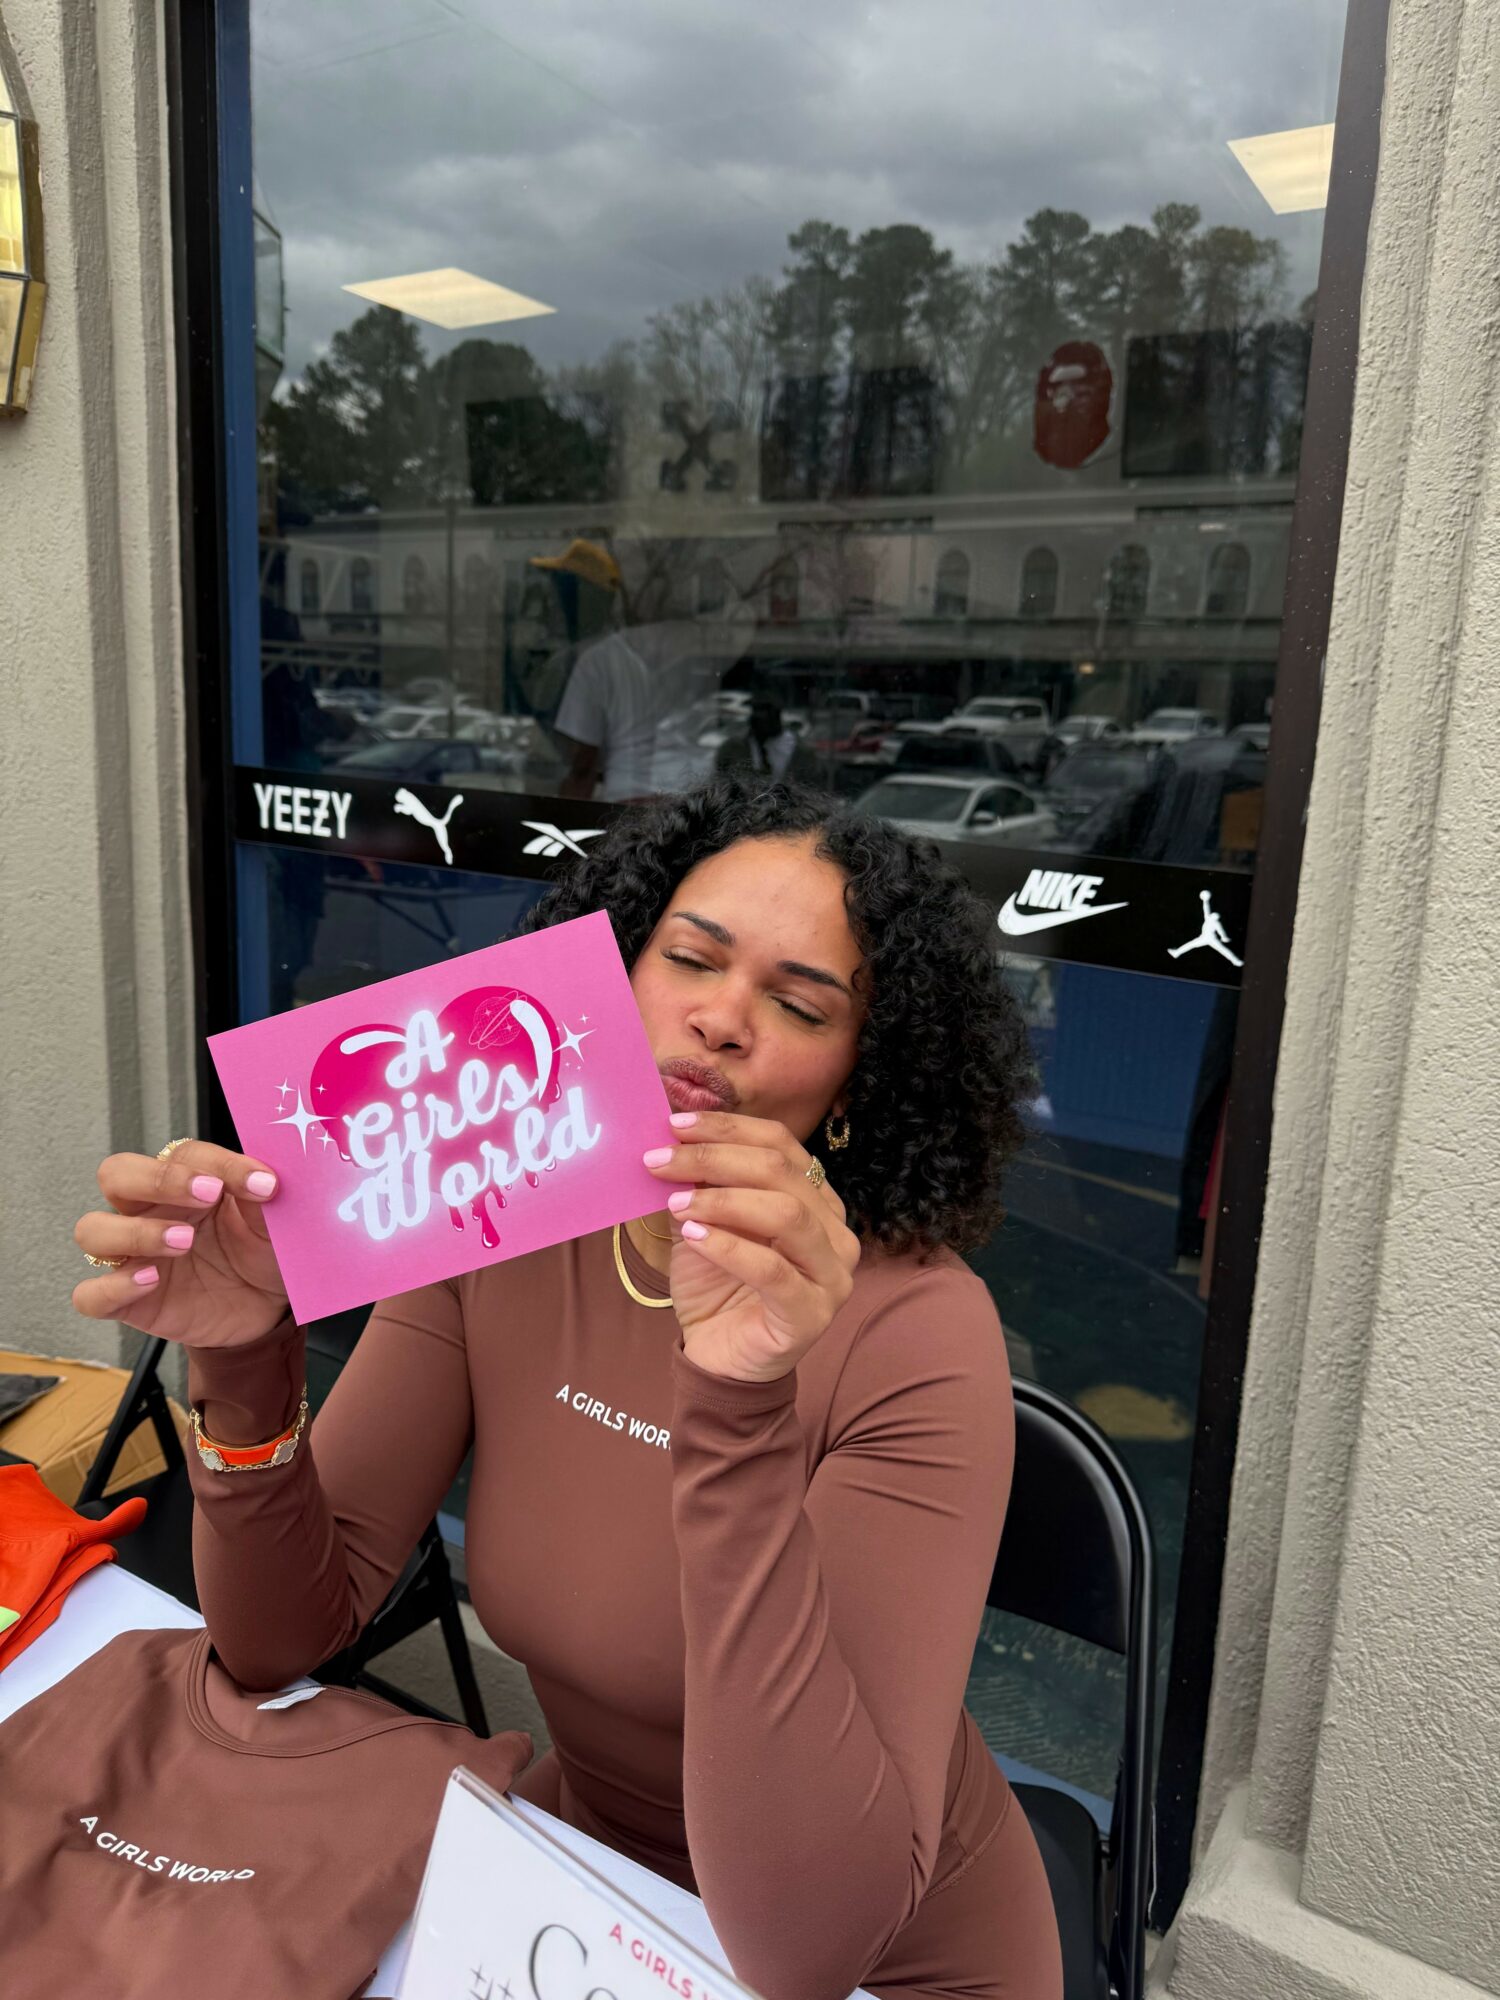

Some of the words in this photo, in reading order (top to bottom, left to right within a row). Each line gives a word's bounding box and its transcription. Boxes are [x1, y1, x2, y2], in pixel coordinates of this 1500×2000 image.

[253, 782, 352, 839] YEEZY
[1016, 869, 1104, 911] NIKE
[386, 1010, 454, 1088] A
[343, 1059, 545, 1171] Girls
[339, 1087, 602, 1240] World
[555, 1384, 569, 1403] A
[572, 1392, 627, 1431] GIRLS
[628, 1418, 671, 1451] WOR
[80, 1816, 98, 1833] A
[96, 1832, 169, 1872] GIRLS
[168, 1861, 255, 1883] WORLD
[609, 1922, 622, 1946] A
[630, 1939, 694, 2000] GIRLS
